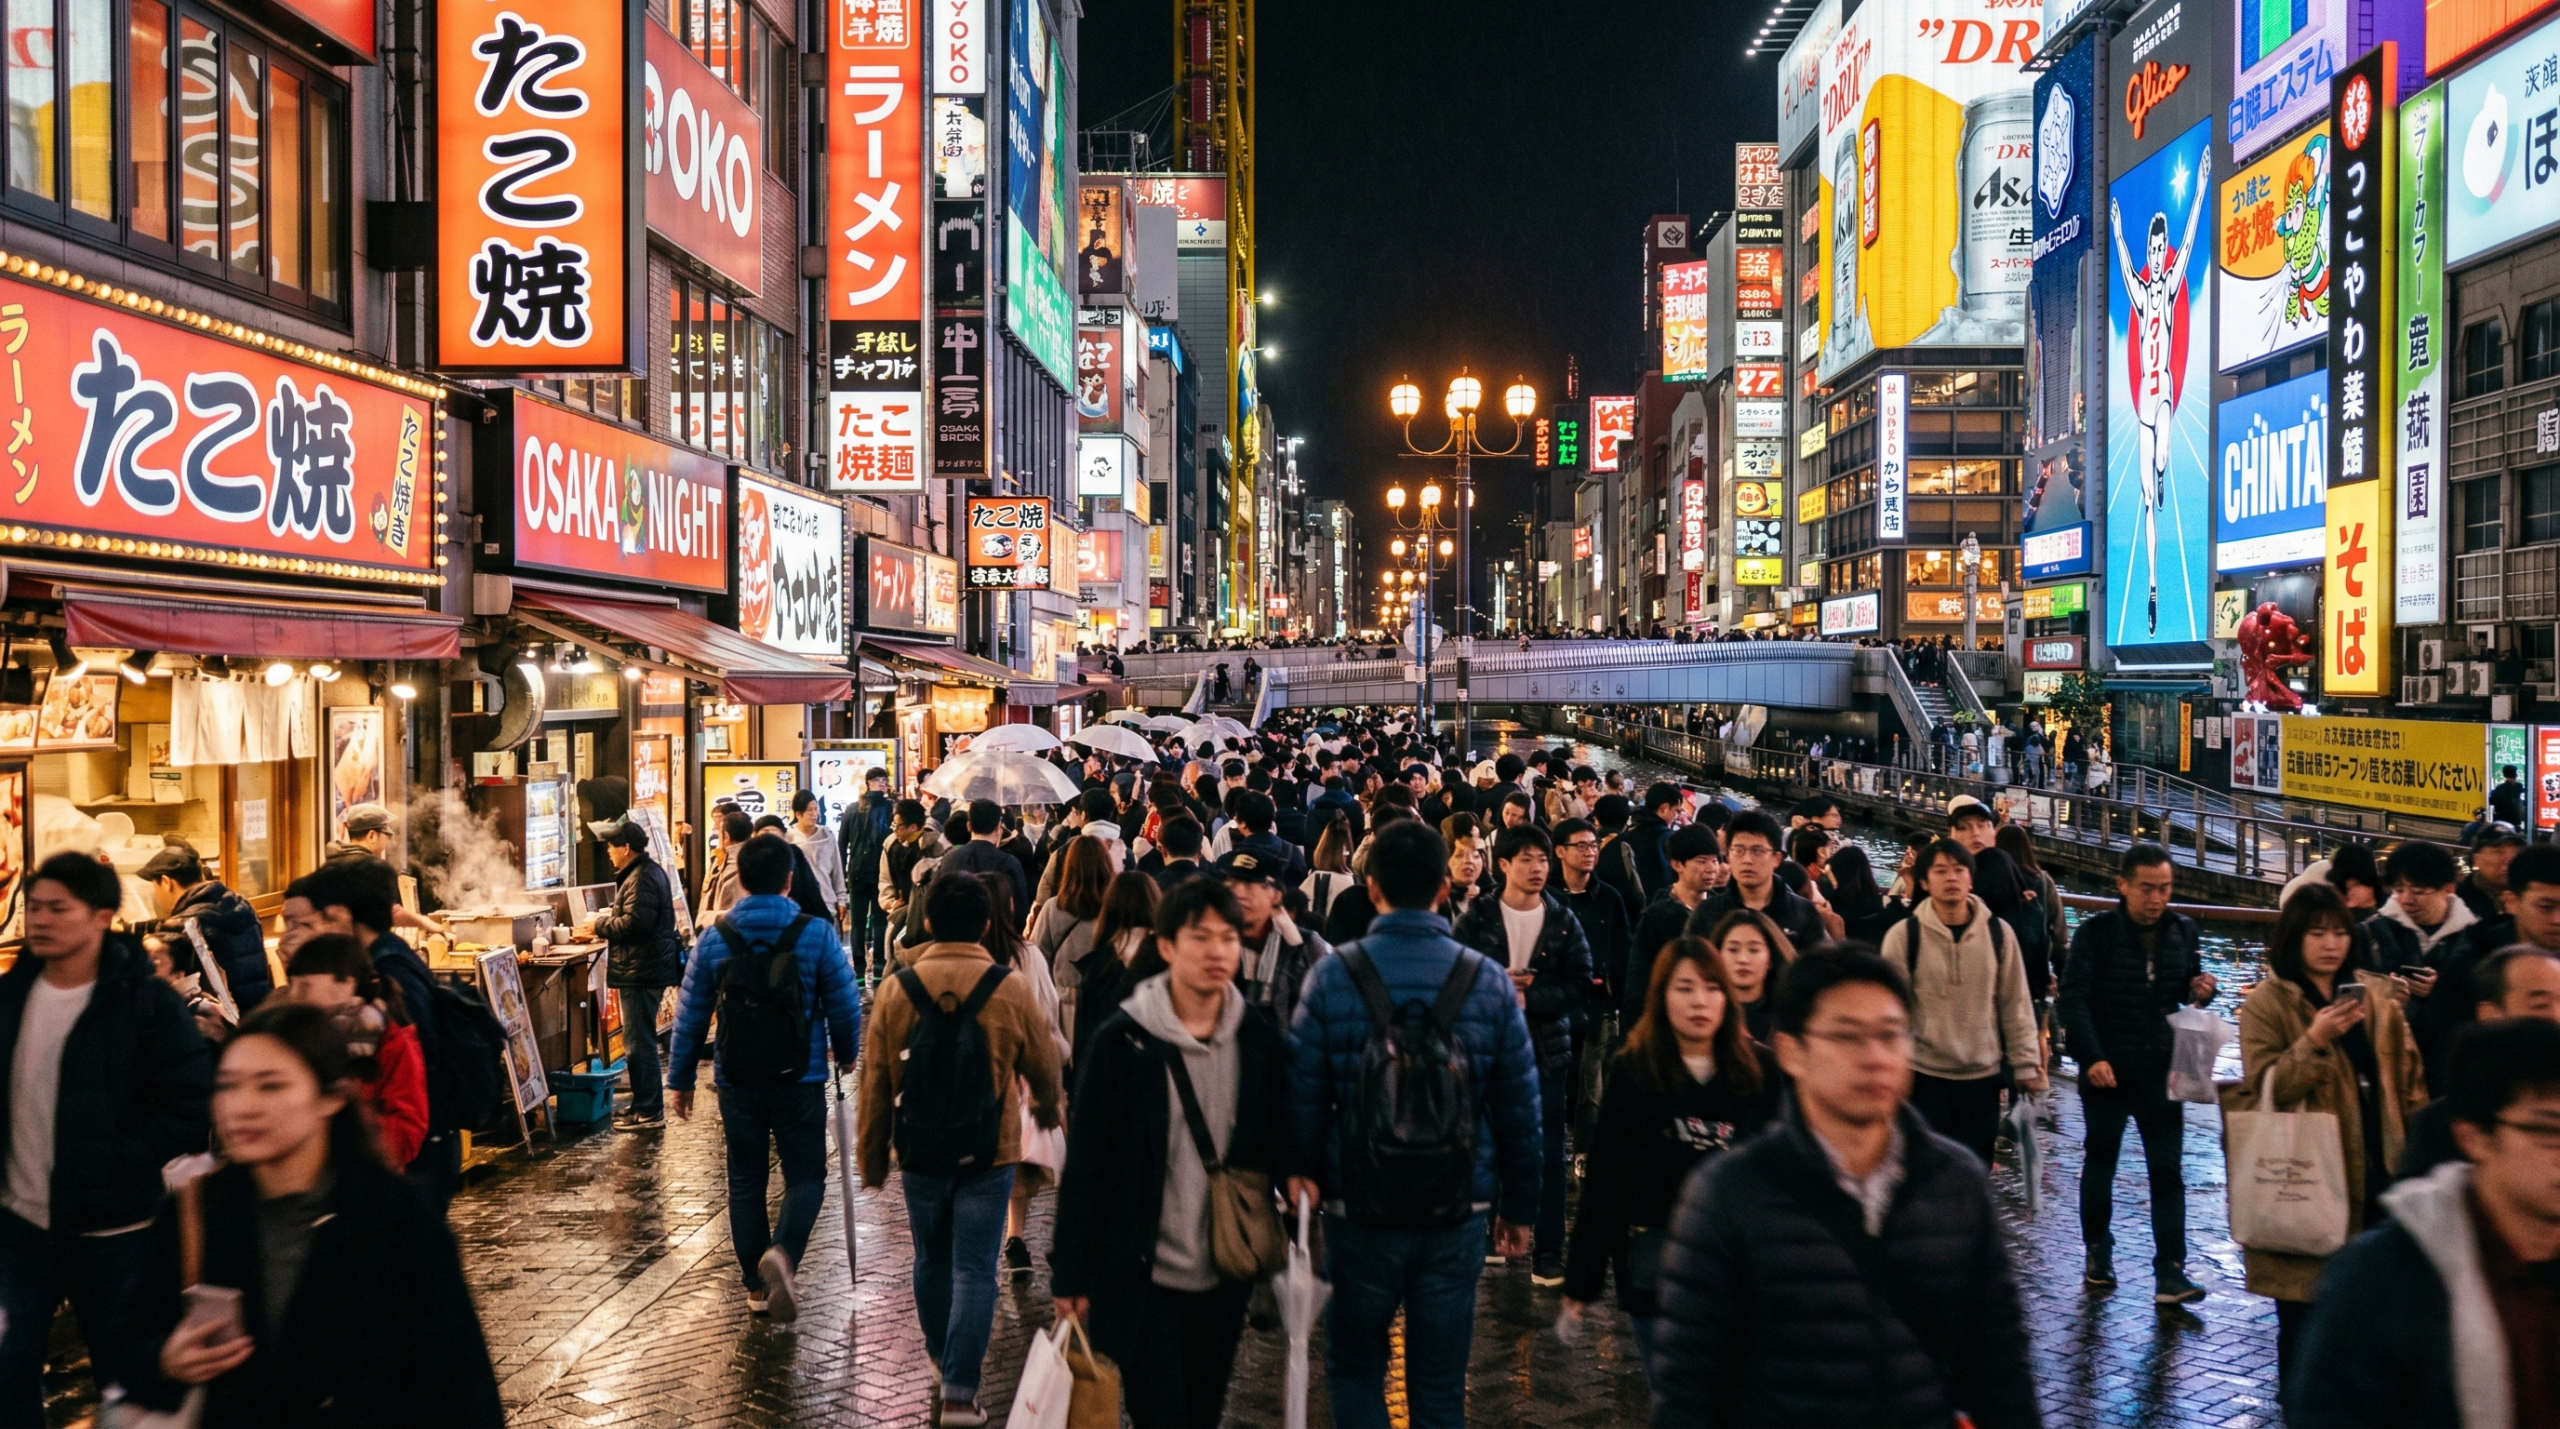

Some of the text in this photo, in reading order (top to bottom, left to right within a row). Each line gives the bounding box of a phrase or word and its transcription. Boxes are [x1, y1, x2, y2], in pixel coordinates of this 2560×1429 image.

[2126, 61, 2189, 140] Glico
[470, 11, 592, 347] たこ焼
[844, 65, 907, 306] ラーメン
[0, 303, 39, 504] ラーメン
[71, 328, 355, 543] たこ焼
[837, 444, 915, 481] 焼麺
[839, 404, 911, 437] たこ
[522, 435, 722, 560] OSAKA NIGHT
[971, 504, 1045, 530] たこ焼
[2336, 523, 2367, 676] そば
